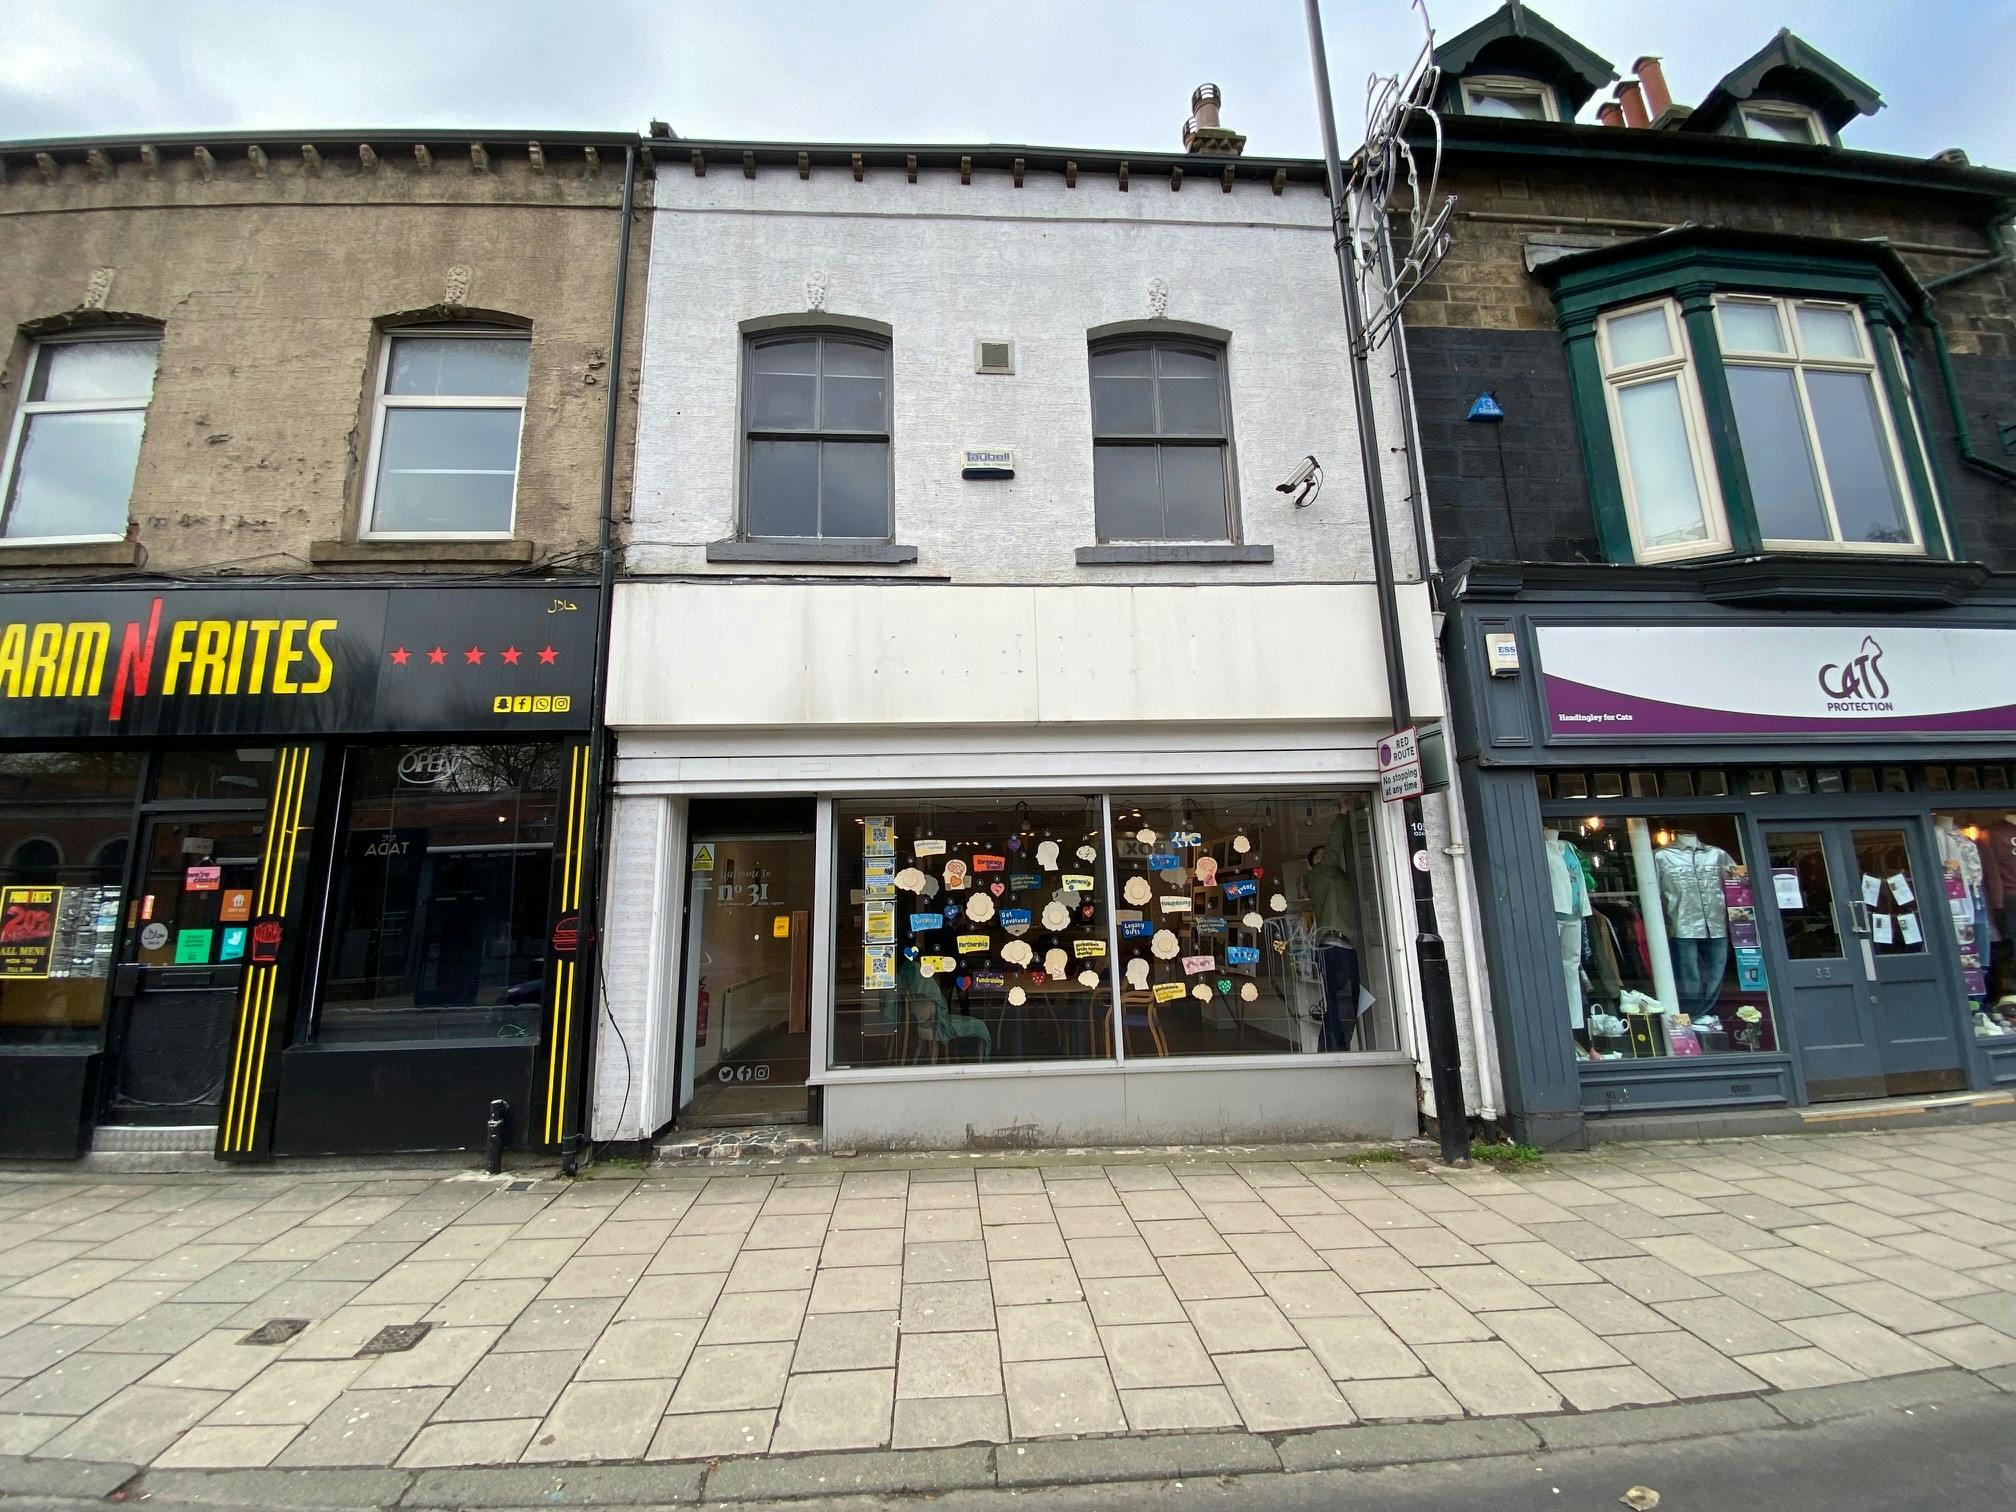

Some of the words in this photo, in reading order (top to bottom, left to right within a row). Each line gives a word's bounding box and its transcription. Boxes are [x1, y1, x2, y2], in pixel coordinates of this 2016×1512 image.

[547, 599, 578, 613] حلال
[0, 622, 111, 697] ARM
[108, 597, 164, 721] N
[162, 619, 338, 696] FRITES
[1827, 702, 1894, 712] PROTECTION
[1558, 713, 1603, 723] Headingley
[1603, 713, 1615, 721] for
[1615, 713, 1633, 721] Cats
[1395, 736, 1410, 749] RED
[1393, 746, 1416, 762] ROUTE
[1383, 774, 1392, 785] No
[1392, 768, 1418, 783] stopping
[1385, 786, 1392, 796] at
[1392, 785, 1403, 796] any
[1403, 782, 1418, 793] time
[1815, 967, 1832, 979] 33
